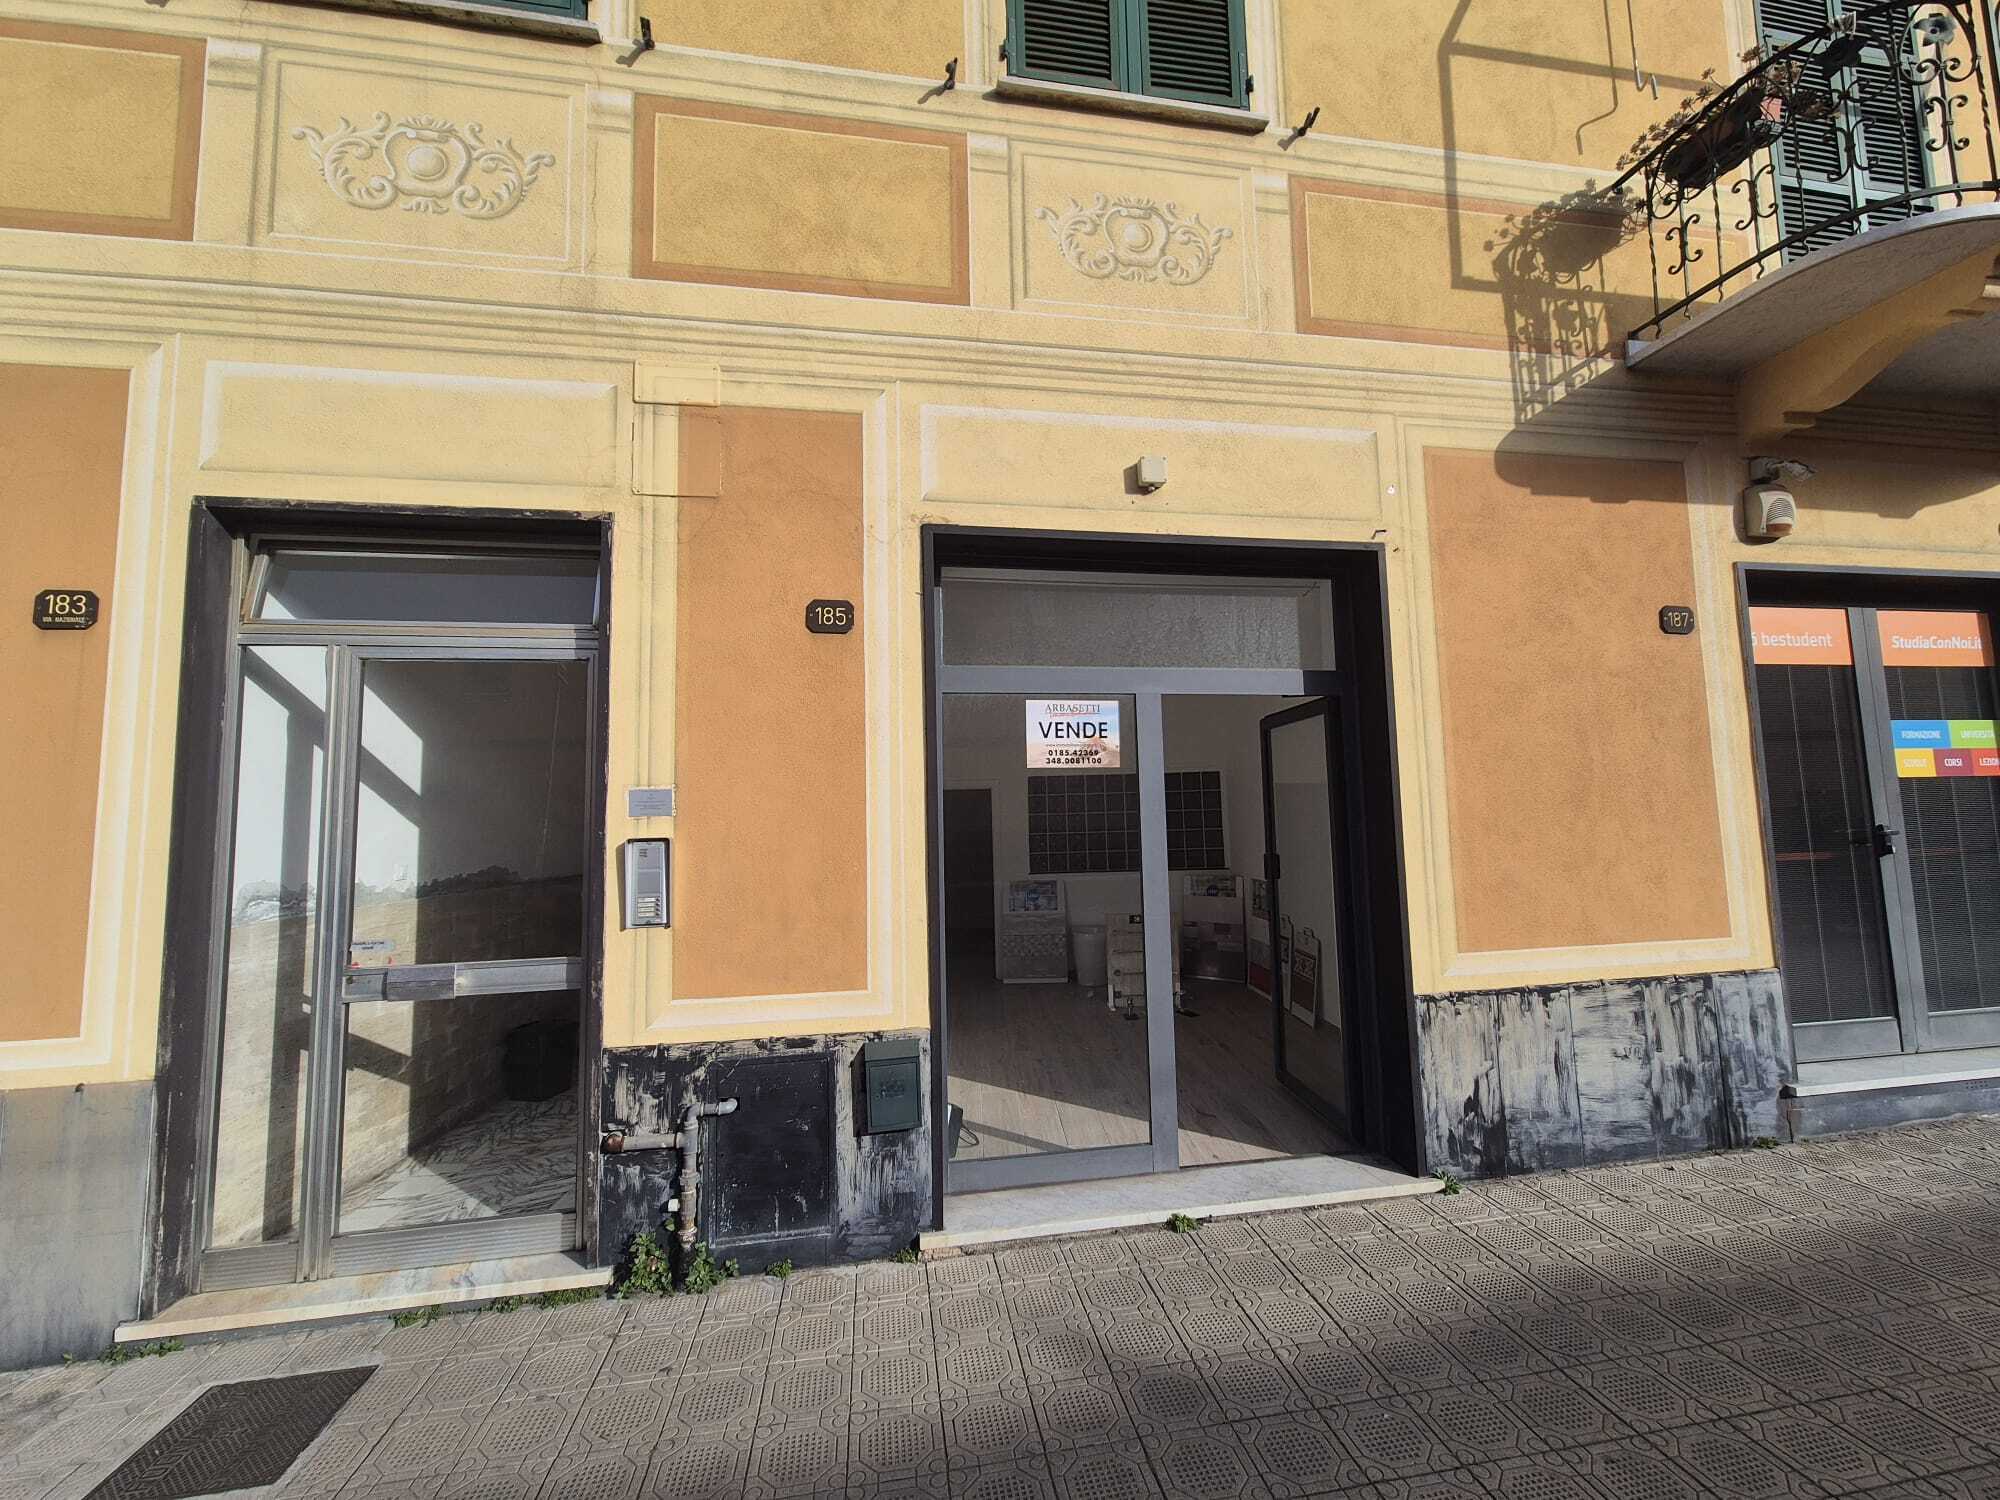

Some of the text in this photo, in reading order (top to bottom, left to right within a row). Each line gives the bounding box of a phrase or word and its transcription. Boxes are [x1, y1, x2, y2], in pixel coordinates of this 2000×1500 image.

[44, 594, 87, 615] 183
[815, 607, 846, 625] 185
[1667, 612, 1689, 627] 187
[1760, 632, 1833, 647] bestudent
[1891, 635, 1984, 649] StudiaConNoi.it
[1045, 703, 1101, 713] ARBASETTI
[1038, 721, 1108, 739] VENDE
[1901, 730, 1941, 739] FORMAZIONE
[1944, 758, 1963, 767] CORSI
